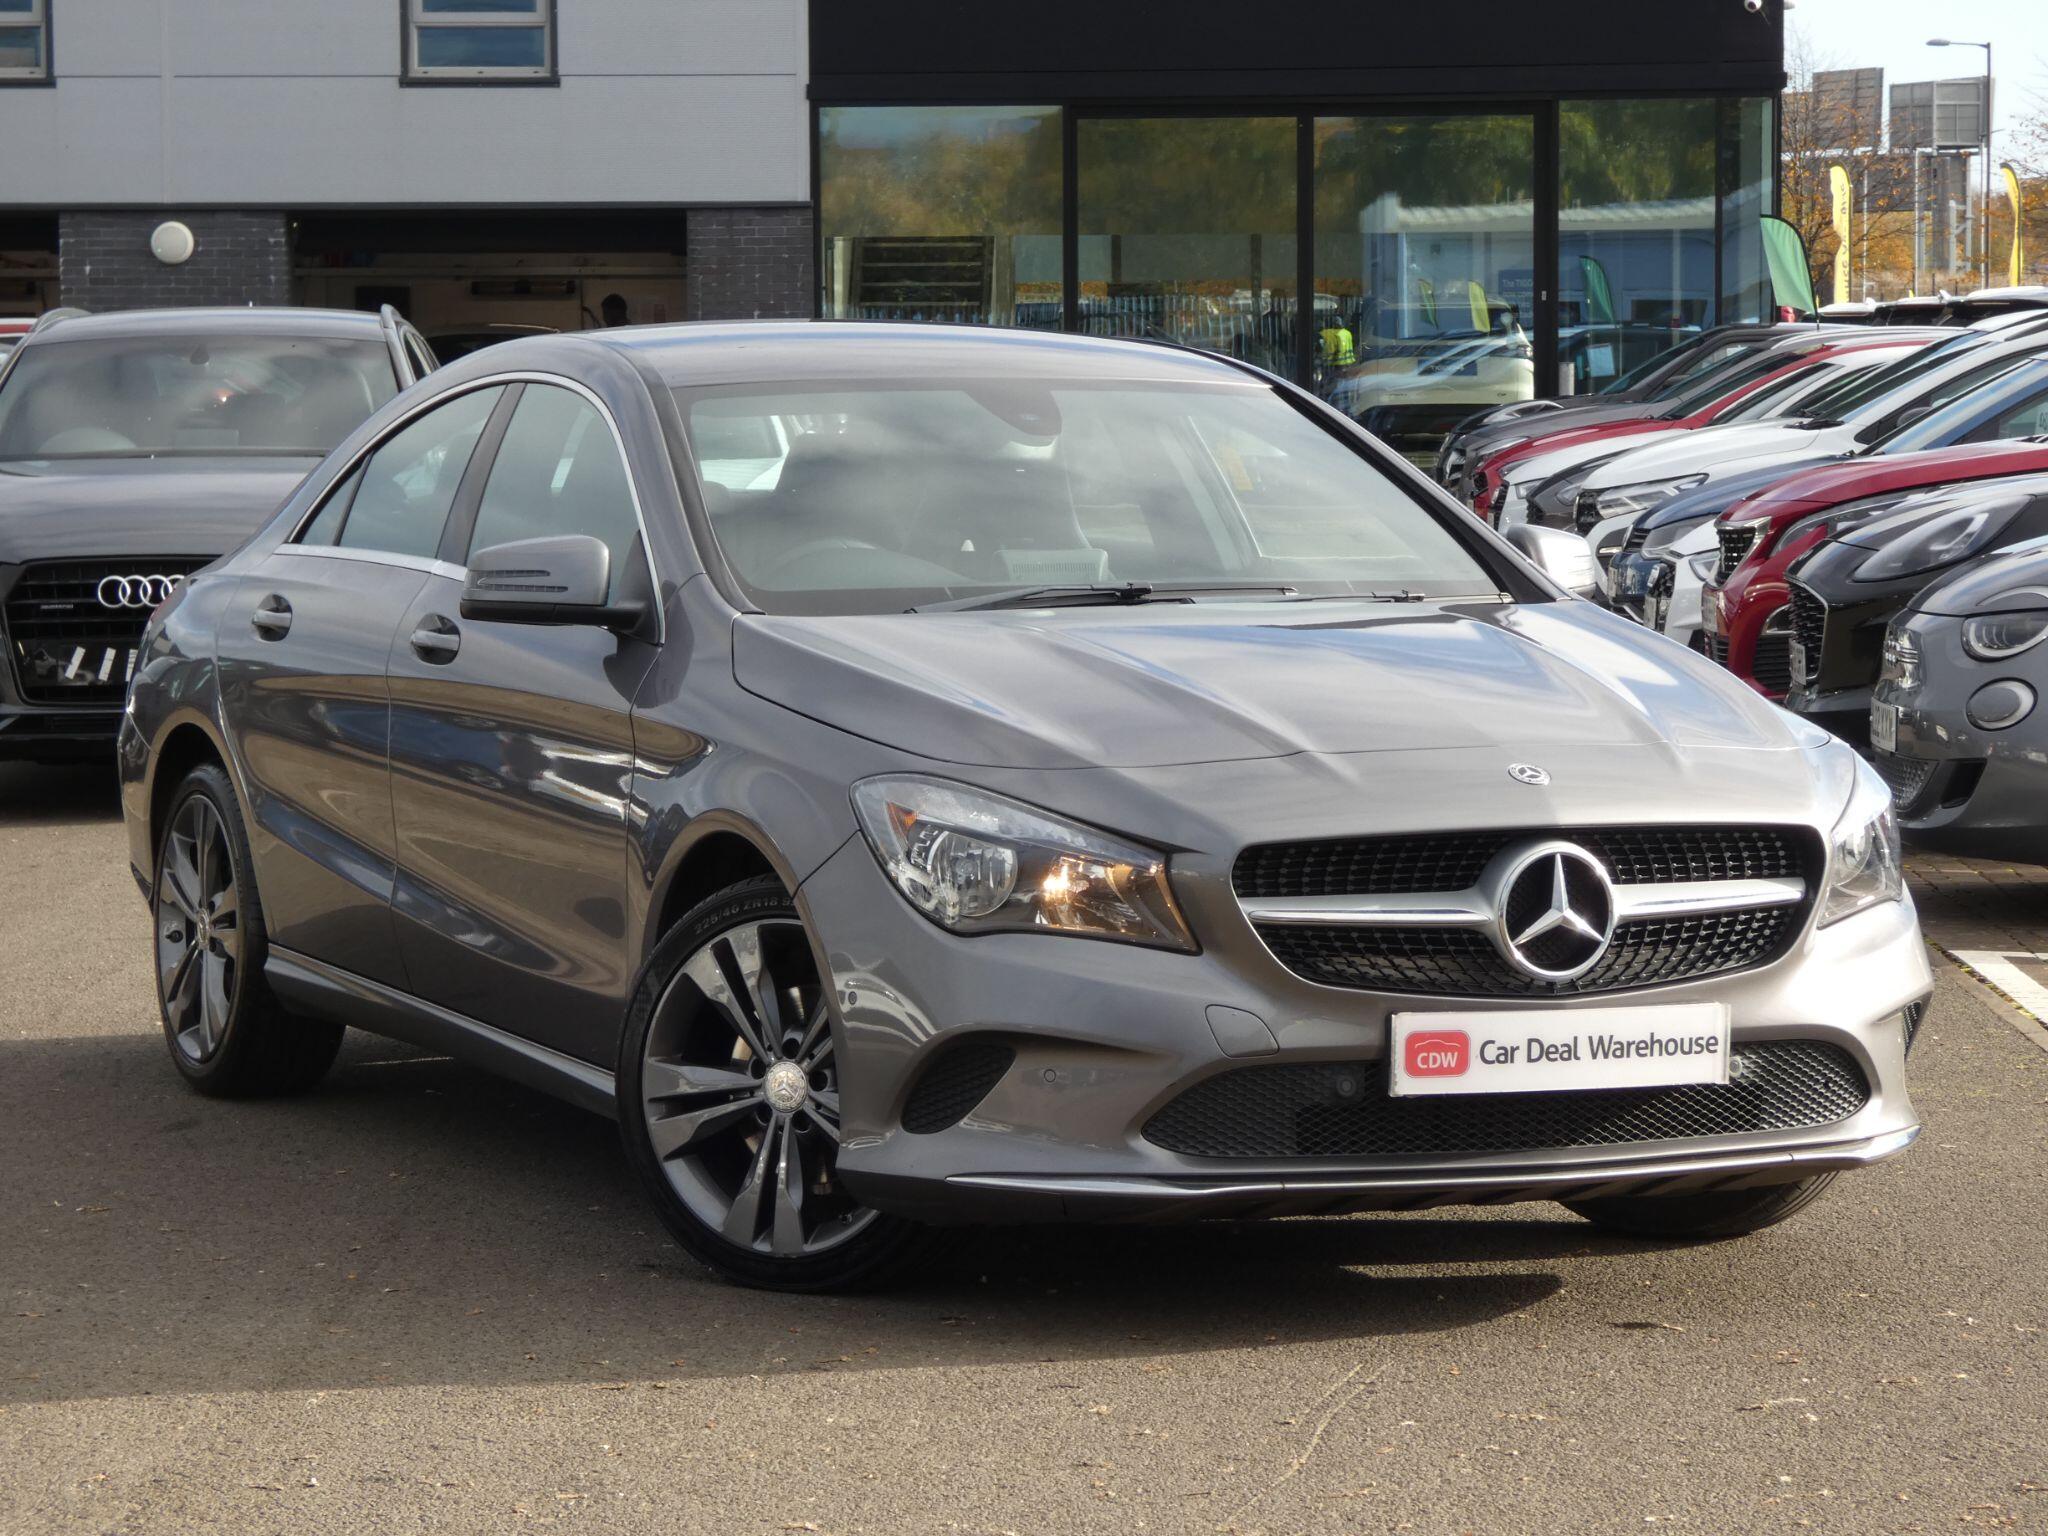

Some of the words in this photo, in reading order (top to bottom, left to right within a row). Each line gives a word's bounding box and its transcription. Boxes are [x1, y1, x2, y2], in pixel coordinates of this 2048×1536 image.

[1416, 1051, 1458, 1070] CDW
[1479, 1039, 1519, 1065] Car
[1526, 1035, 1580, 1064] Deal
[1588, 1032, 1719, 1060] Warehouse
